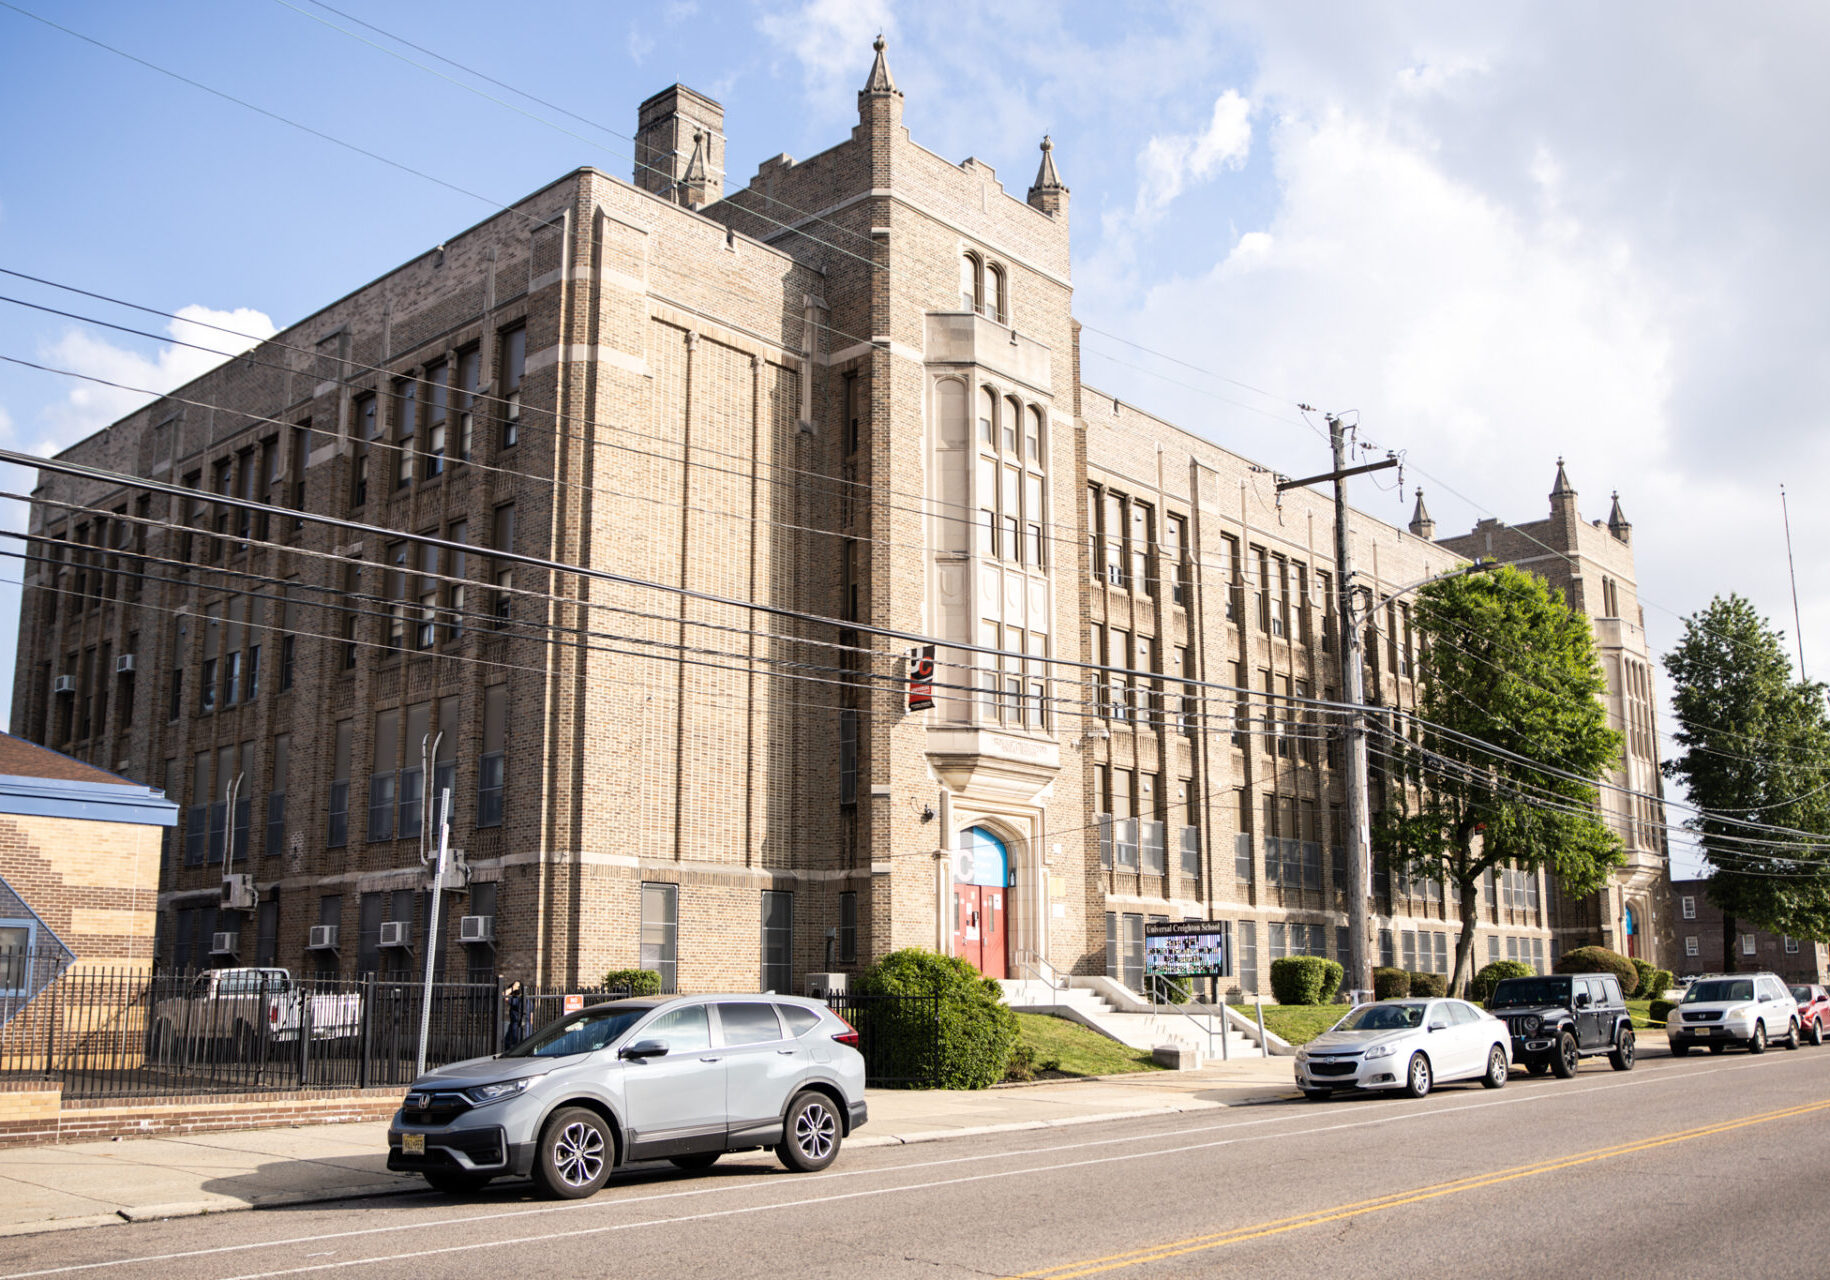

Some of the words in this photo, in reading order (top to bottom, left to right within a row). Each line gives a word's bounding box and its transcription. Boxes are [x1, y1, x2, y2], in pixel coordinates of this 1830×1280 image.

[1146, 924, 1172, 933] Universal
[1173, 924, 1200, 933] Creighton
[1201, 922, 1220, 931] School
